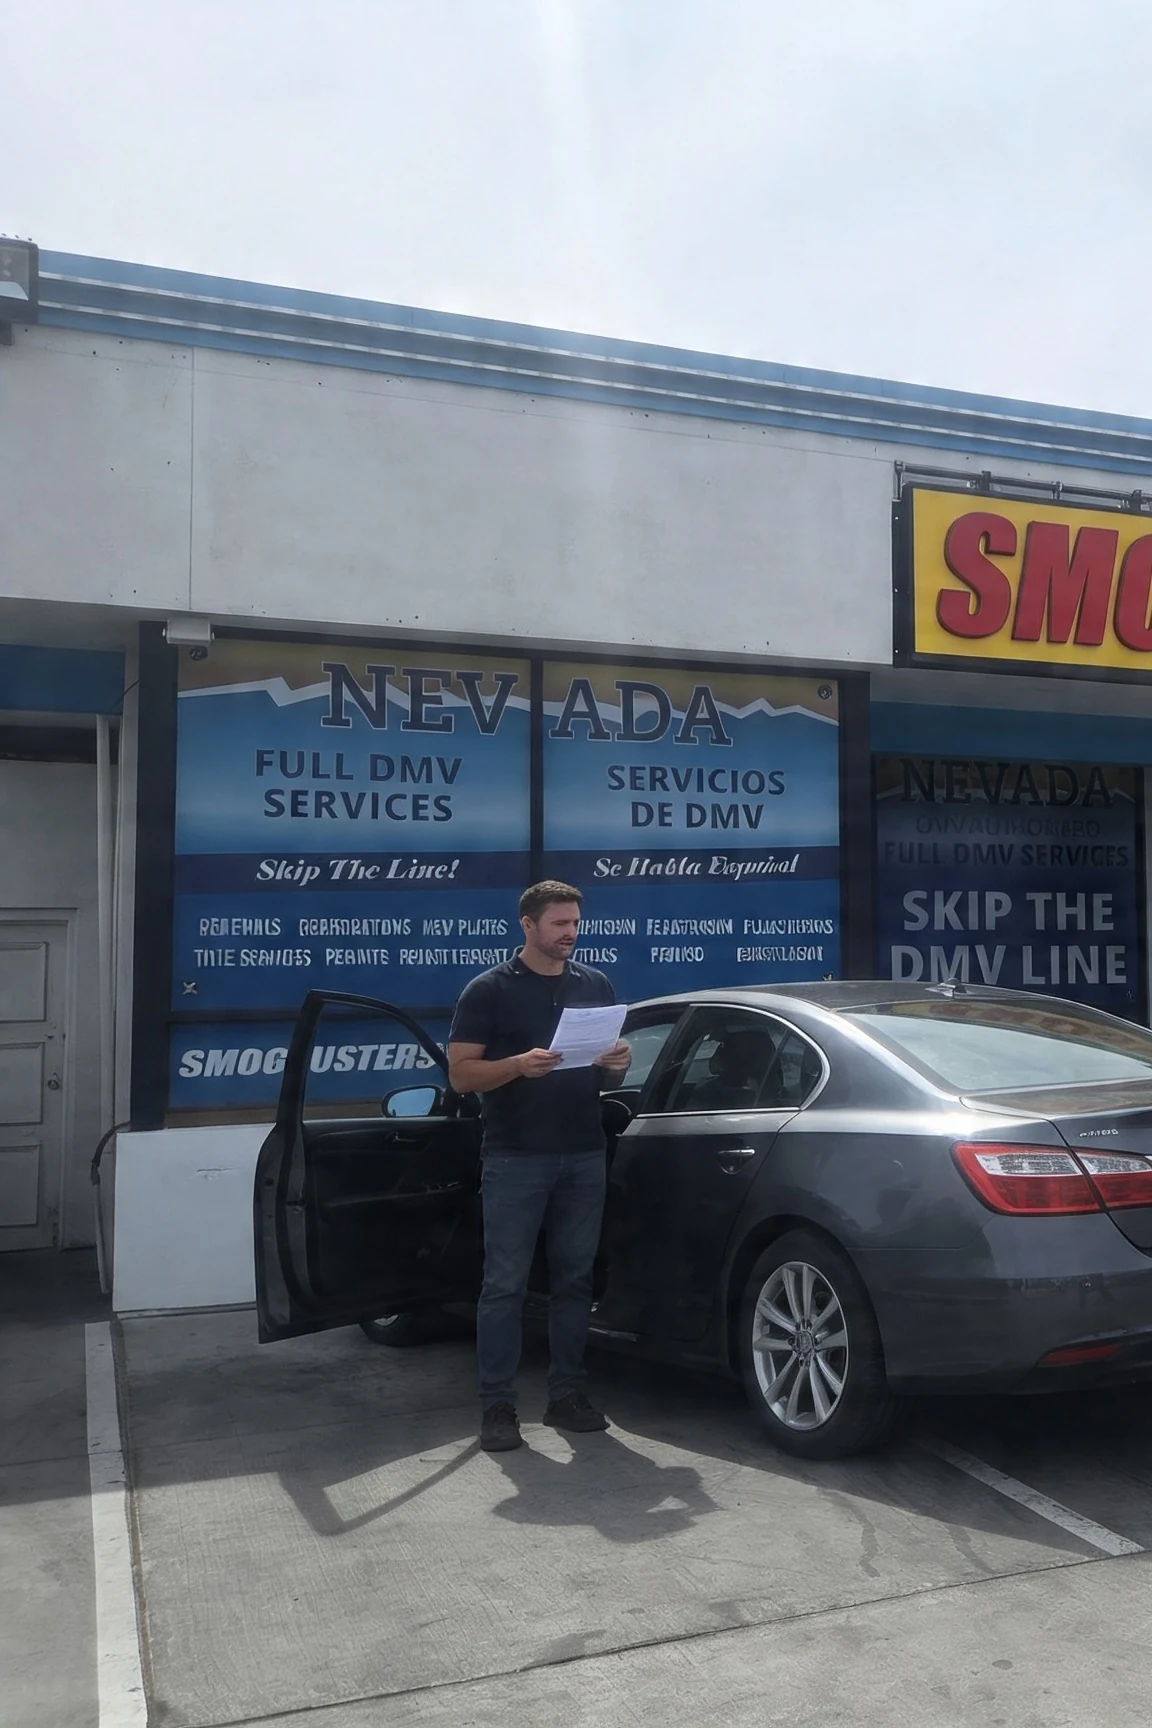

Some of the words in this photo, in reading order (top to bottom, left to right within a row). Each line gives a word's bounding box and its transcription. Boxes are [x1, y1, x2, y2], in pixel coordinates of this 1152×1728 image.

[255, 749, 354, 780] FULL
[369, 753, 463, 785] DMV
[607, 765, 785, 795] SERVICIOS
[900, 758, 1113, 808] NEVADA
[263, 788, 453, 822] SERVICES
[631, 801, 673, 828] DE
[686, 803, 764, 830] DMV
[884, 841, 945, 865] FULL
[954, 842, 1013, 866] DMV
[1020, 844, 1129, 868] SERVICES
[256, 858, 321, 886] Skip
[903, 890, 1012, 931] SKIP
[1026, 892, 1115, 932] THE
[891, 945, 1006, 985] DMV
[1022, 945, 1127, 985] LINE
[178, 1047, 289, 1078] SMOG
